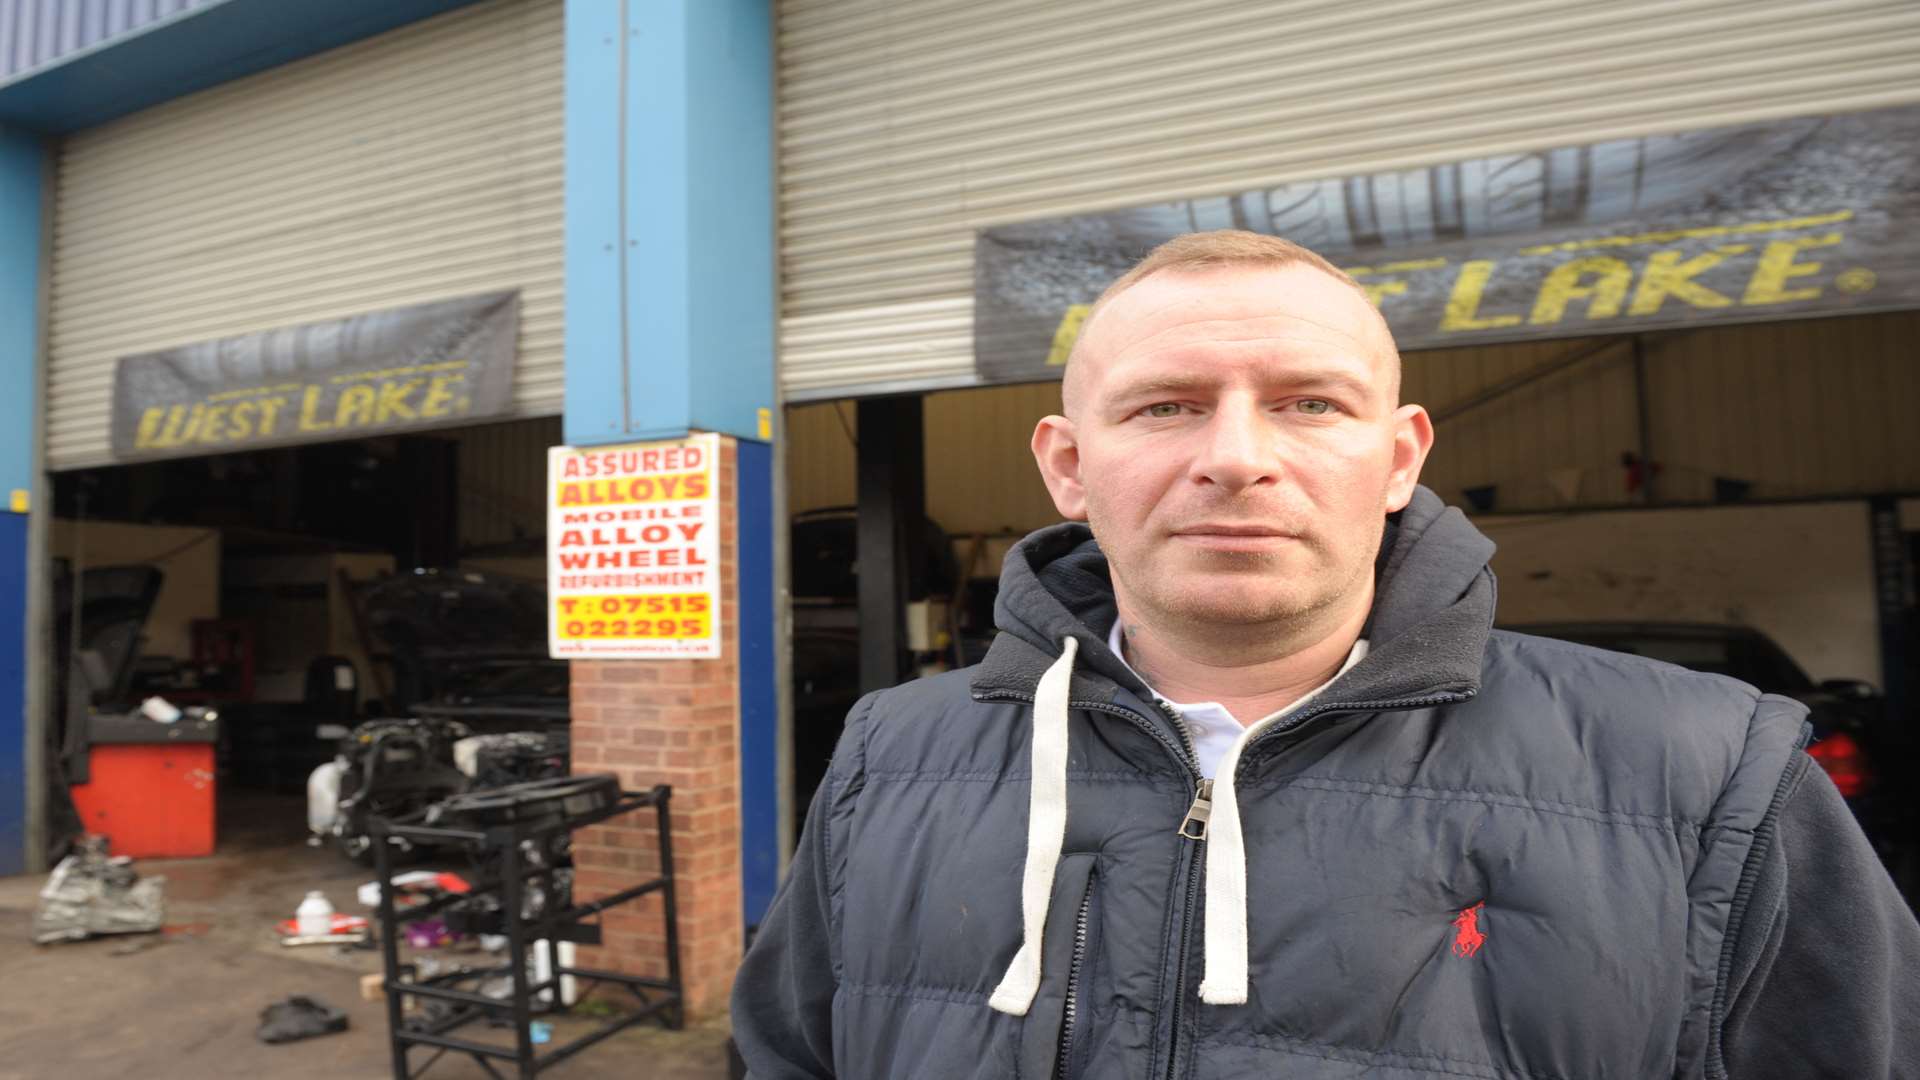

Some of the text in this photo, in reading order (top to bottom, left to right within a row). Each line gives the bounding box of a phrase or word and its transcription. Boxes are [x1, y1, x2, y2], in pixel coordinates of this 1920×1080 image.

[1439, 232, 1843, 332] LAKE
[134, 375, 465, 449] WEST LAKE
[564, 447, 702, 477] ASSURED
[560, 474, 706, 505] ALLOYS
[563, 506, 701, 524] MOBILE
[559, 522, 704, 547] ALLOY
[558, 548, 707, 570] WHEEL
[559, 572, 705, 589] REFURBISHMENT
[565, 619, 702, 637] 022295
